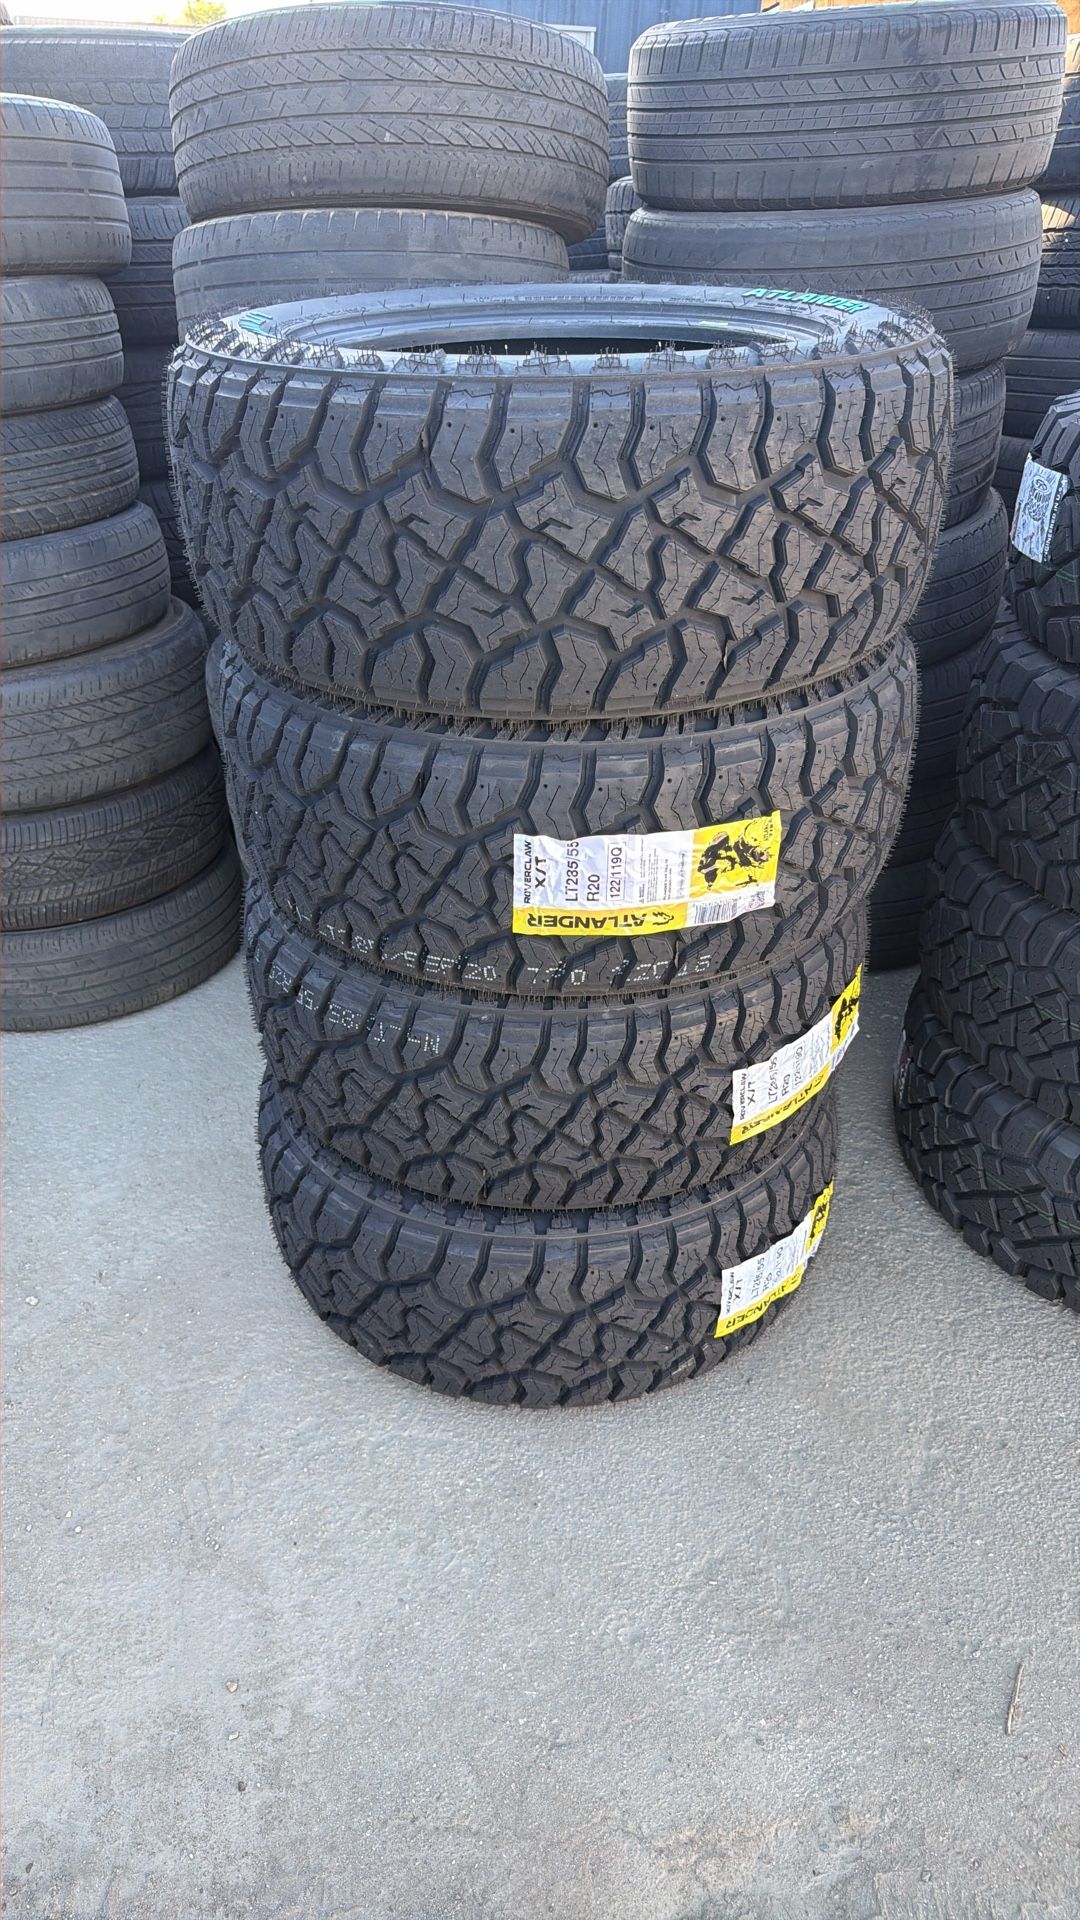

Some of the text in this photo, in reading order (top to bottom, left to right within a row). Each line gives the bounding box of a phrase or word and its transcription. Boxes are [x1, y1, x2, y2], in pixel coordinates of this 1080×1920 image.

[741, 288, 870, 314] ATLANDER
[523, 839, 532, 904] ROVERCLAW
[535, 856, 547, 889] X/T
[565, 841, 579, 902] LT285/55
[586, 874, 601, 902] R20
[609, 847, 622, 899] 122/119Q
[527, 913, 647, 929] ATLANDER
